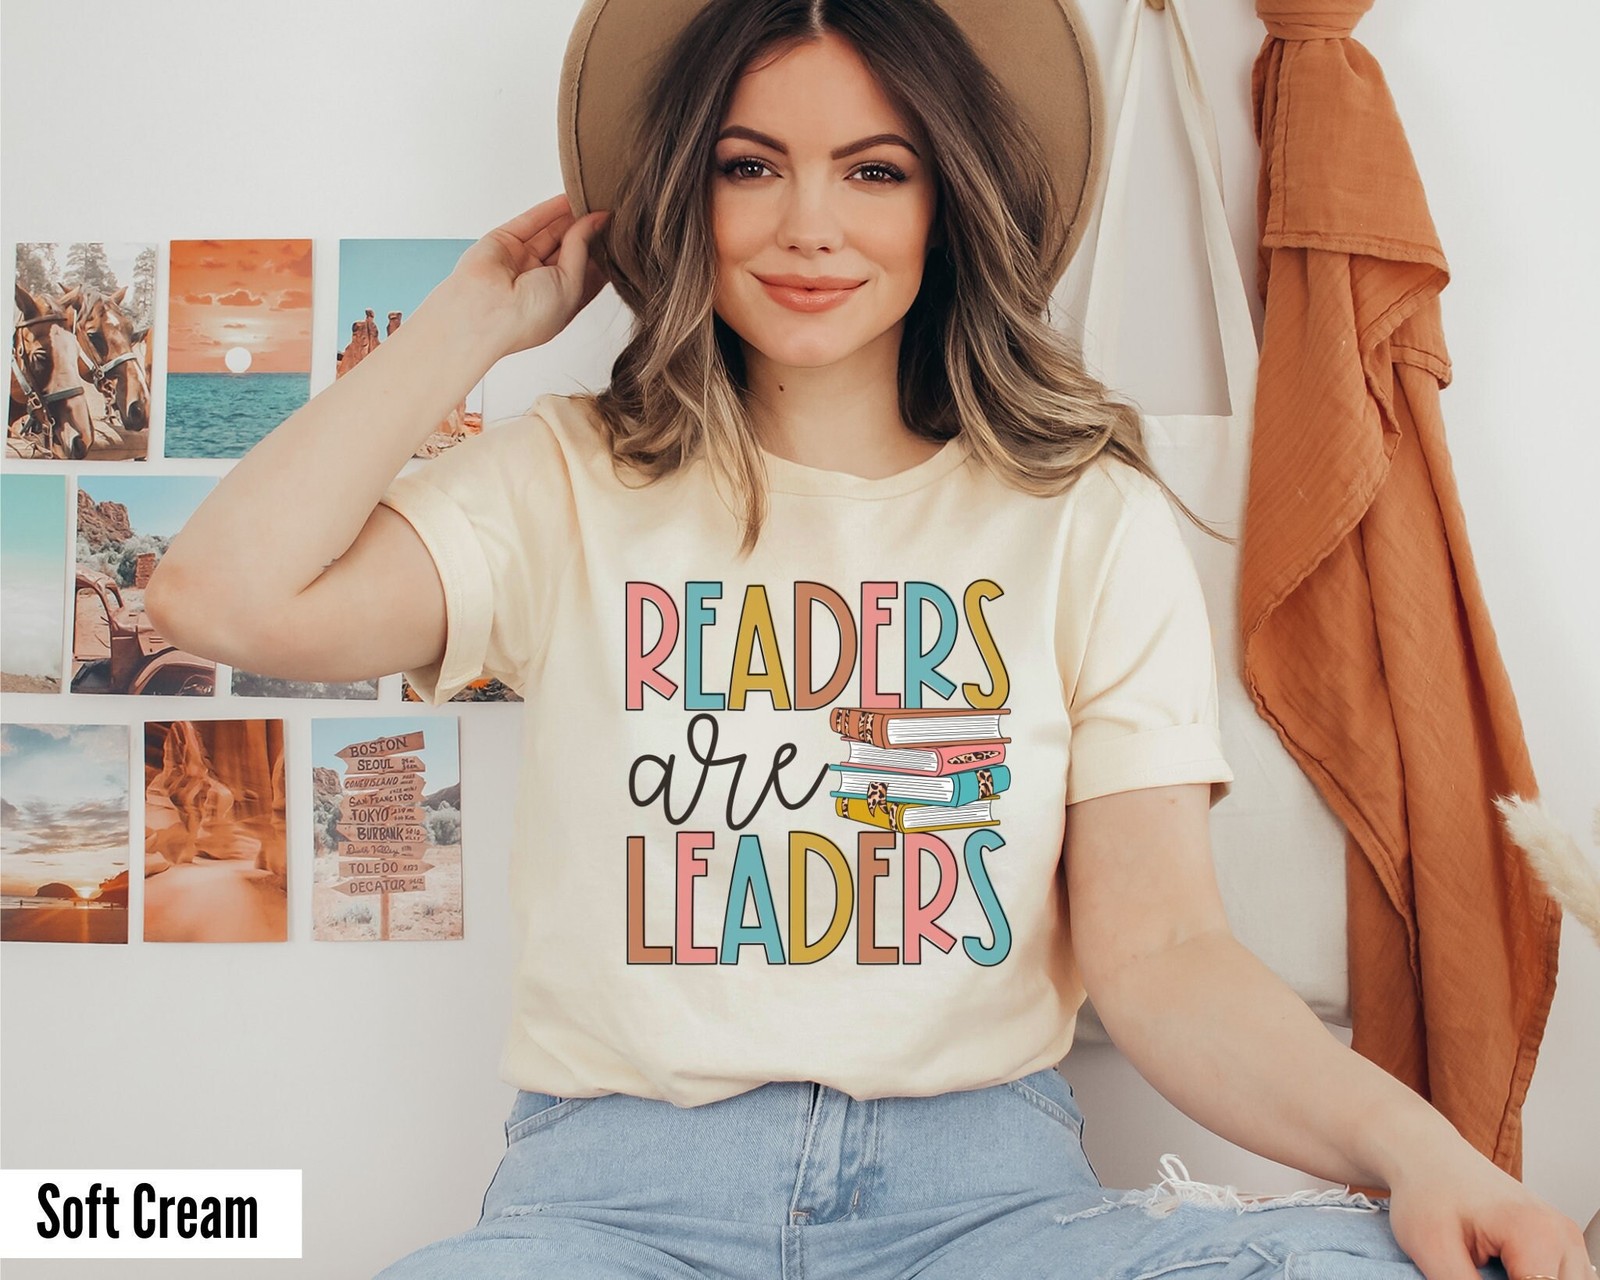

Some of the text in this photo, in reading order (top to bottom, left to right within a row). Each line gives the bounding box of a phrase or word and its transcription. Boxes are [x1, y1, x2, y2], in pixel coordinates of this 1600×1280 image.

[626, 579, 1010, 711] READERS
[349, 737, 408, 758] BOSTON
[357, 759, 394, 771] SEOUL
[628, 713, 830, 831] are
[351, 807, 391, 823] TOKYO
[356, 827, 404, 842] BURBANK
[349, 862, 399, 874] TOLEDO
[627, 829, 1012, 967] LEADERS
